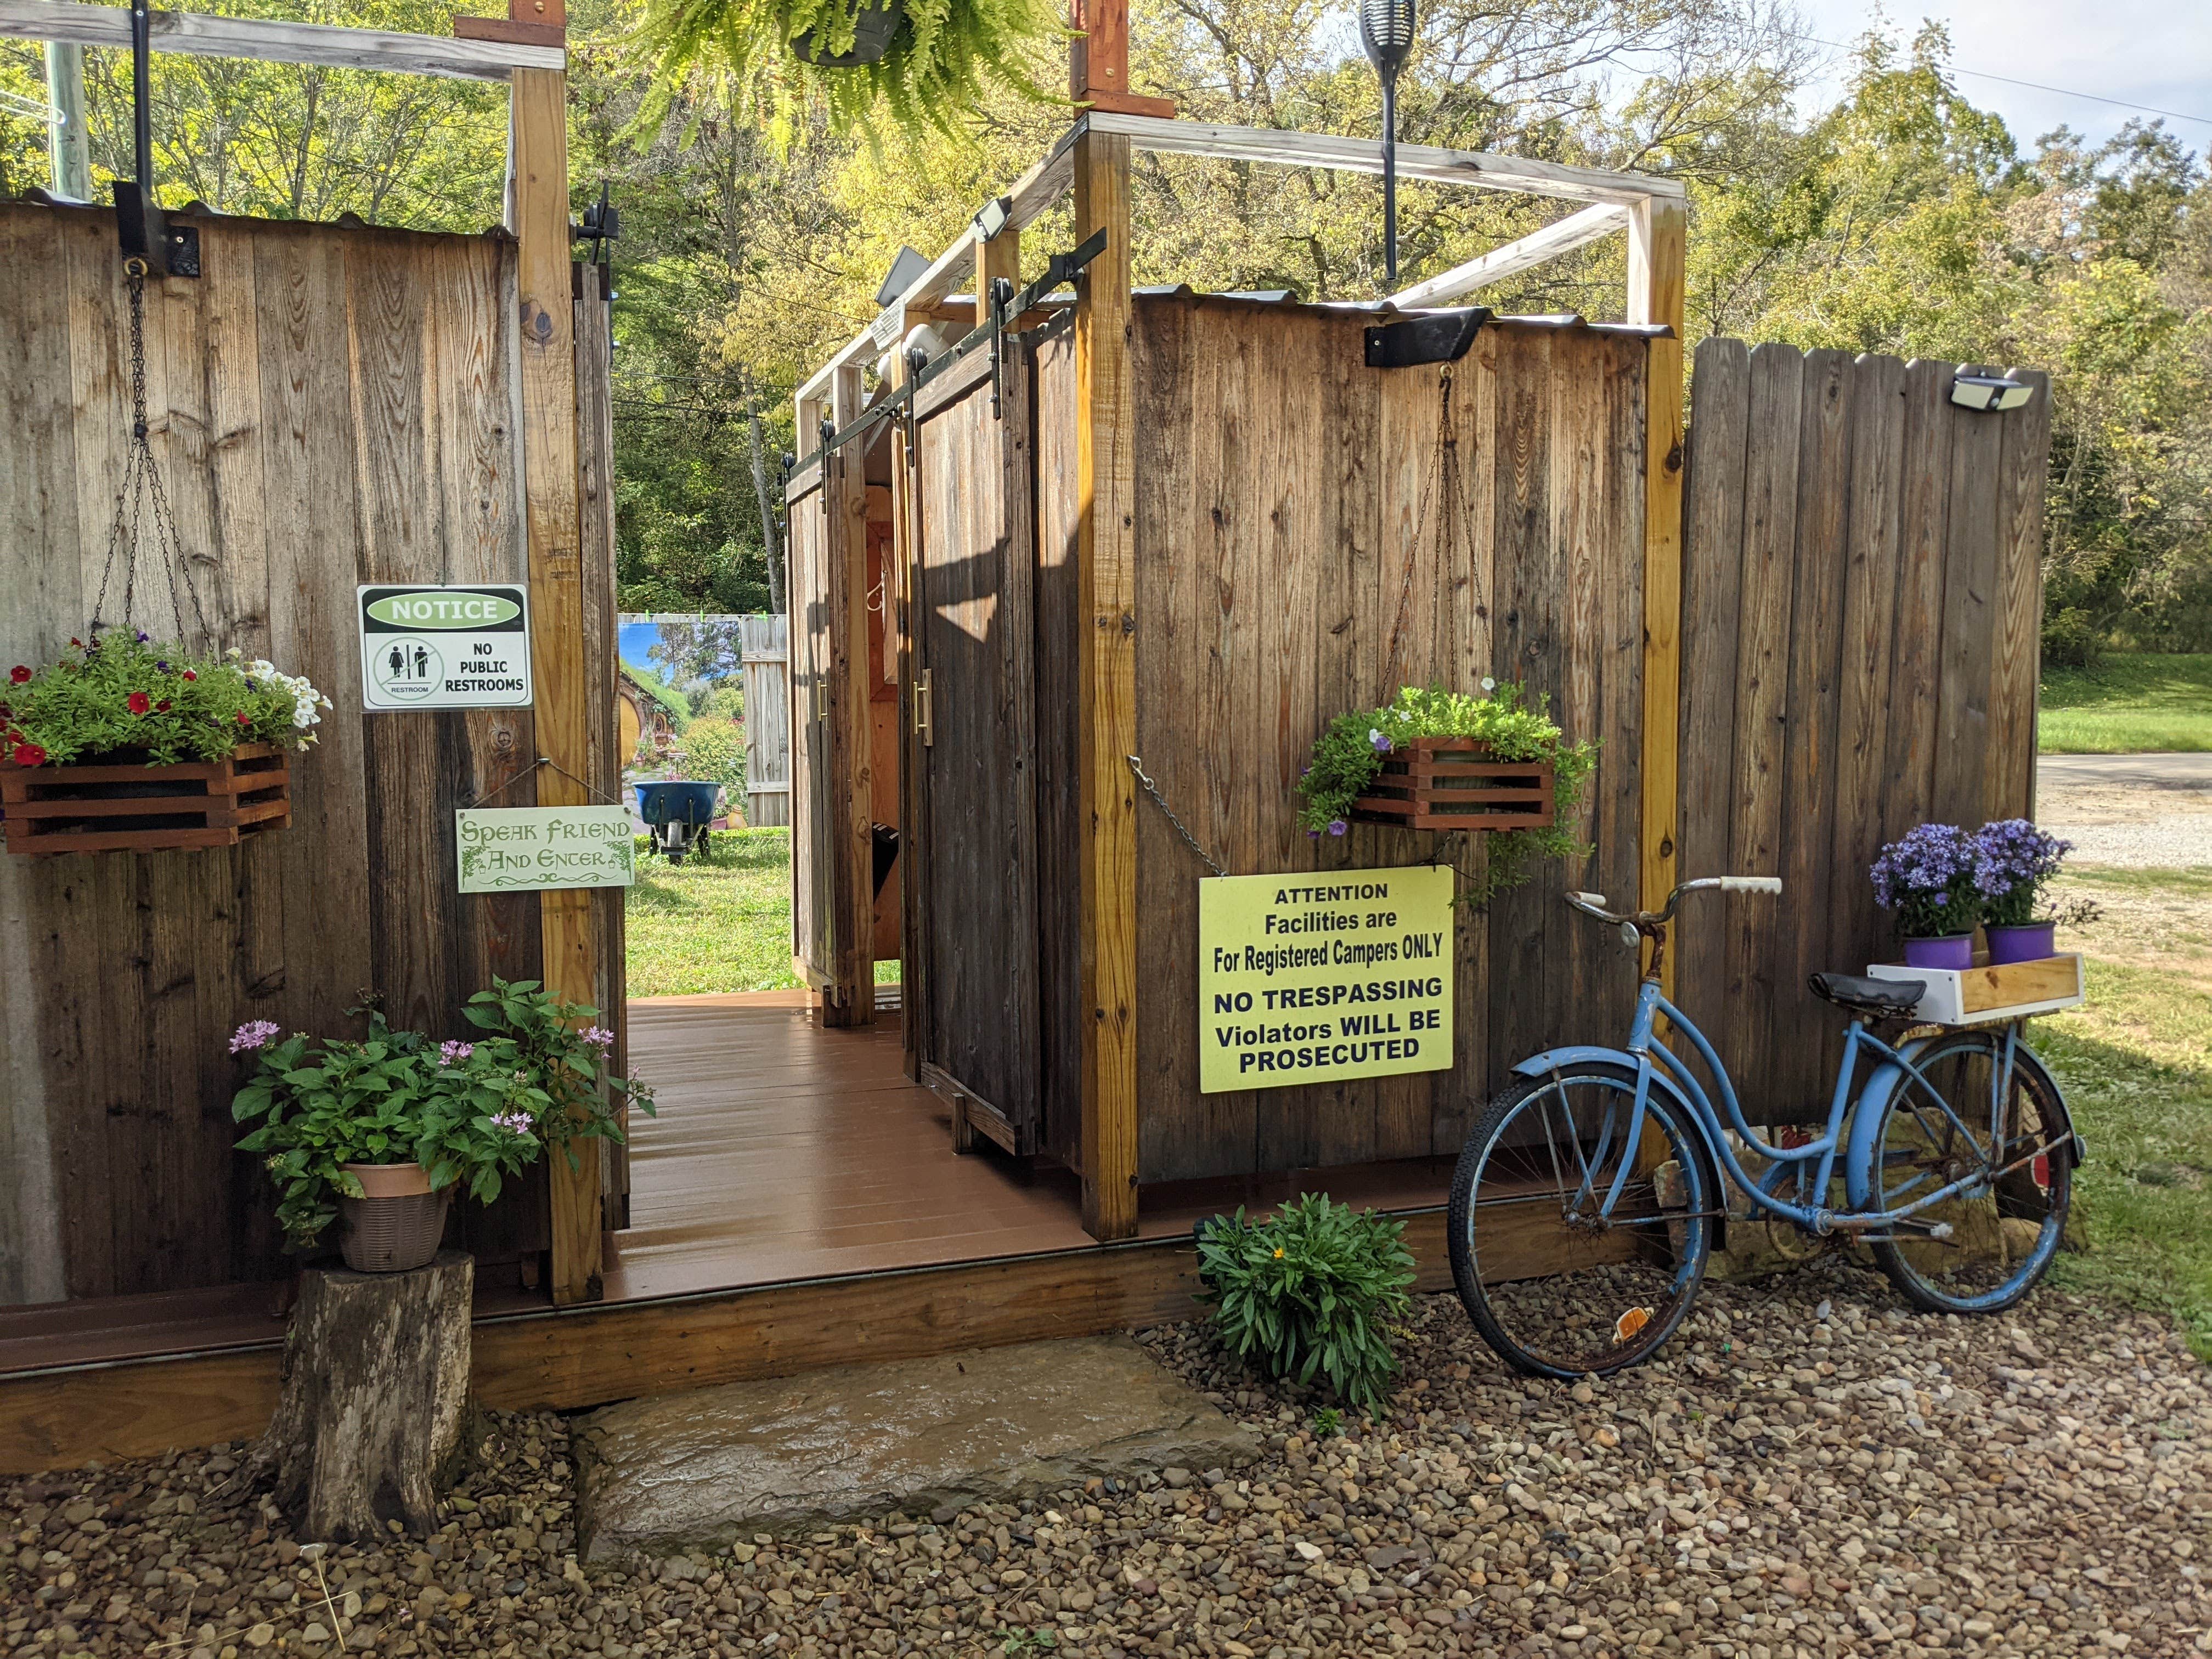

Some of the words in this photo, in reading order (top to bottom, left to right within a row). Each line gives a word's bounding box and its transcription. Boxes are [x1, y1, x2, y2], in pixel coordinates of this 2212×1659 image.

[392, 600, 498, 619] NOTICE
[473, 643, 492, 655] NO
[460, 661, 507, 673] PUBLIC
[445, 679, 523, 691] RESTROOMS
[1274, 883, 1388, 904] ATTENTION
[1265, 911, 1358, 934] Facilities
[1365, 911, 1397, 928] are
[1214, 947, 1239, 972] For
[1245, 940, 1328, 976] Registered
[1333, 939, 1397, 968] Campers
[1402, 933, 1443, 959] ONLY
[1215, 992, 1253, 1014] NO
[1262, 977, 1442, 1010] TRESPASSING
[1215, 1023, 1331, 1047] Violators
[1340, 1013, 1400, 1036] WILL
[1409, 1009, 1440, 1031] BE
[1240, 1038, 1419, 1073] PROSECUTED
